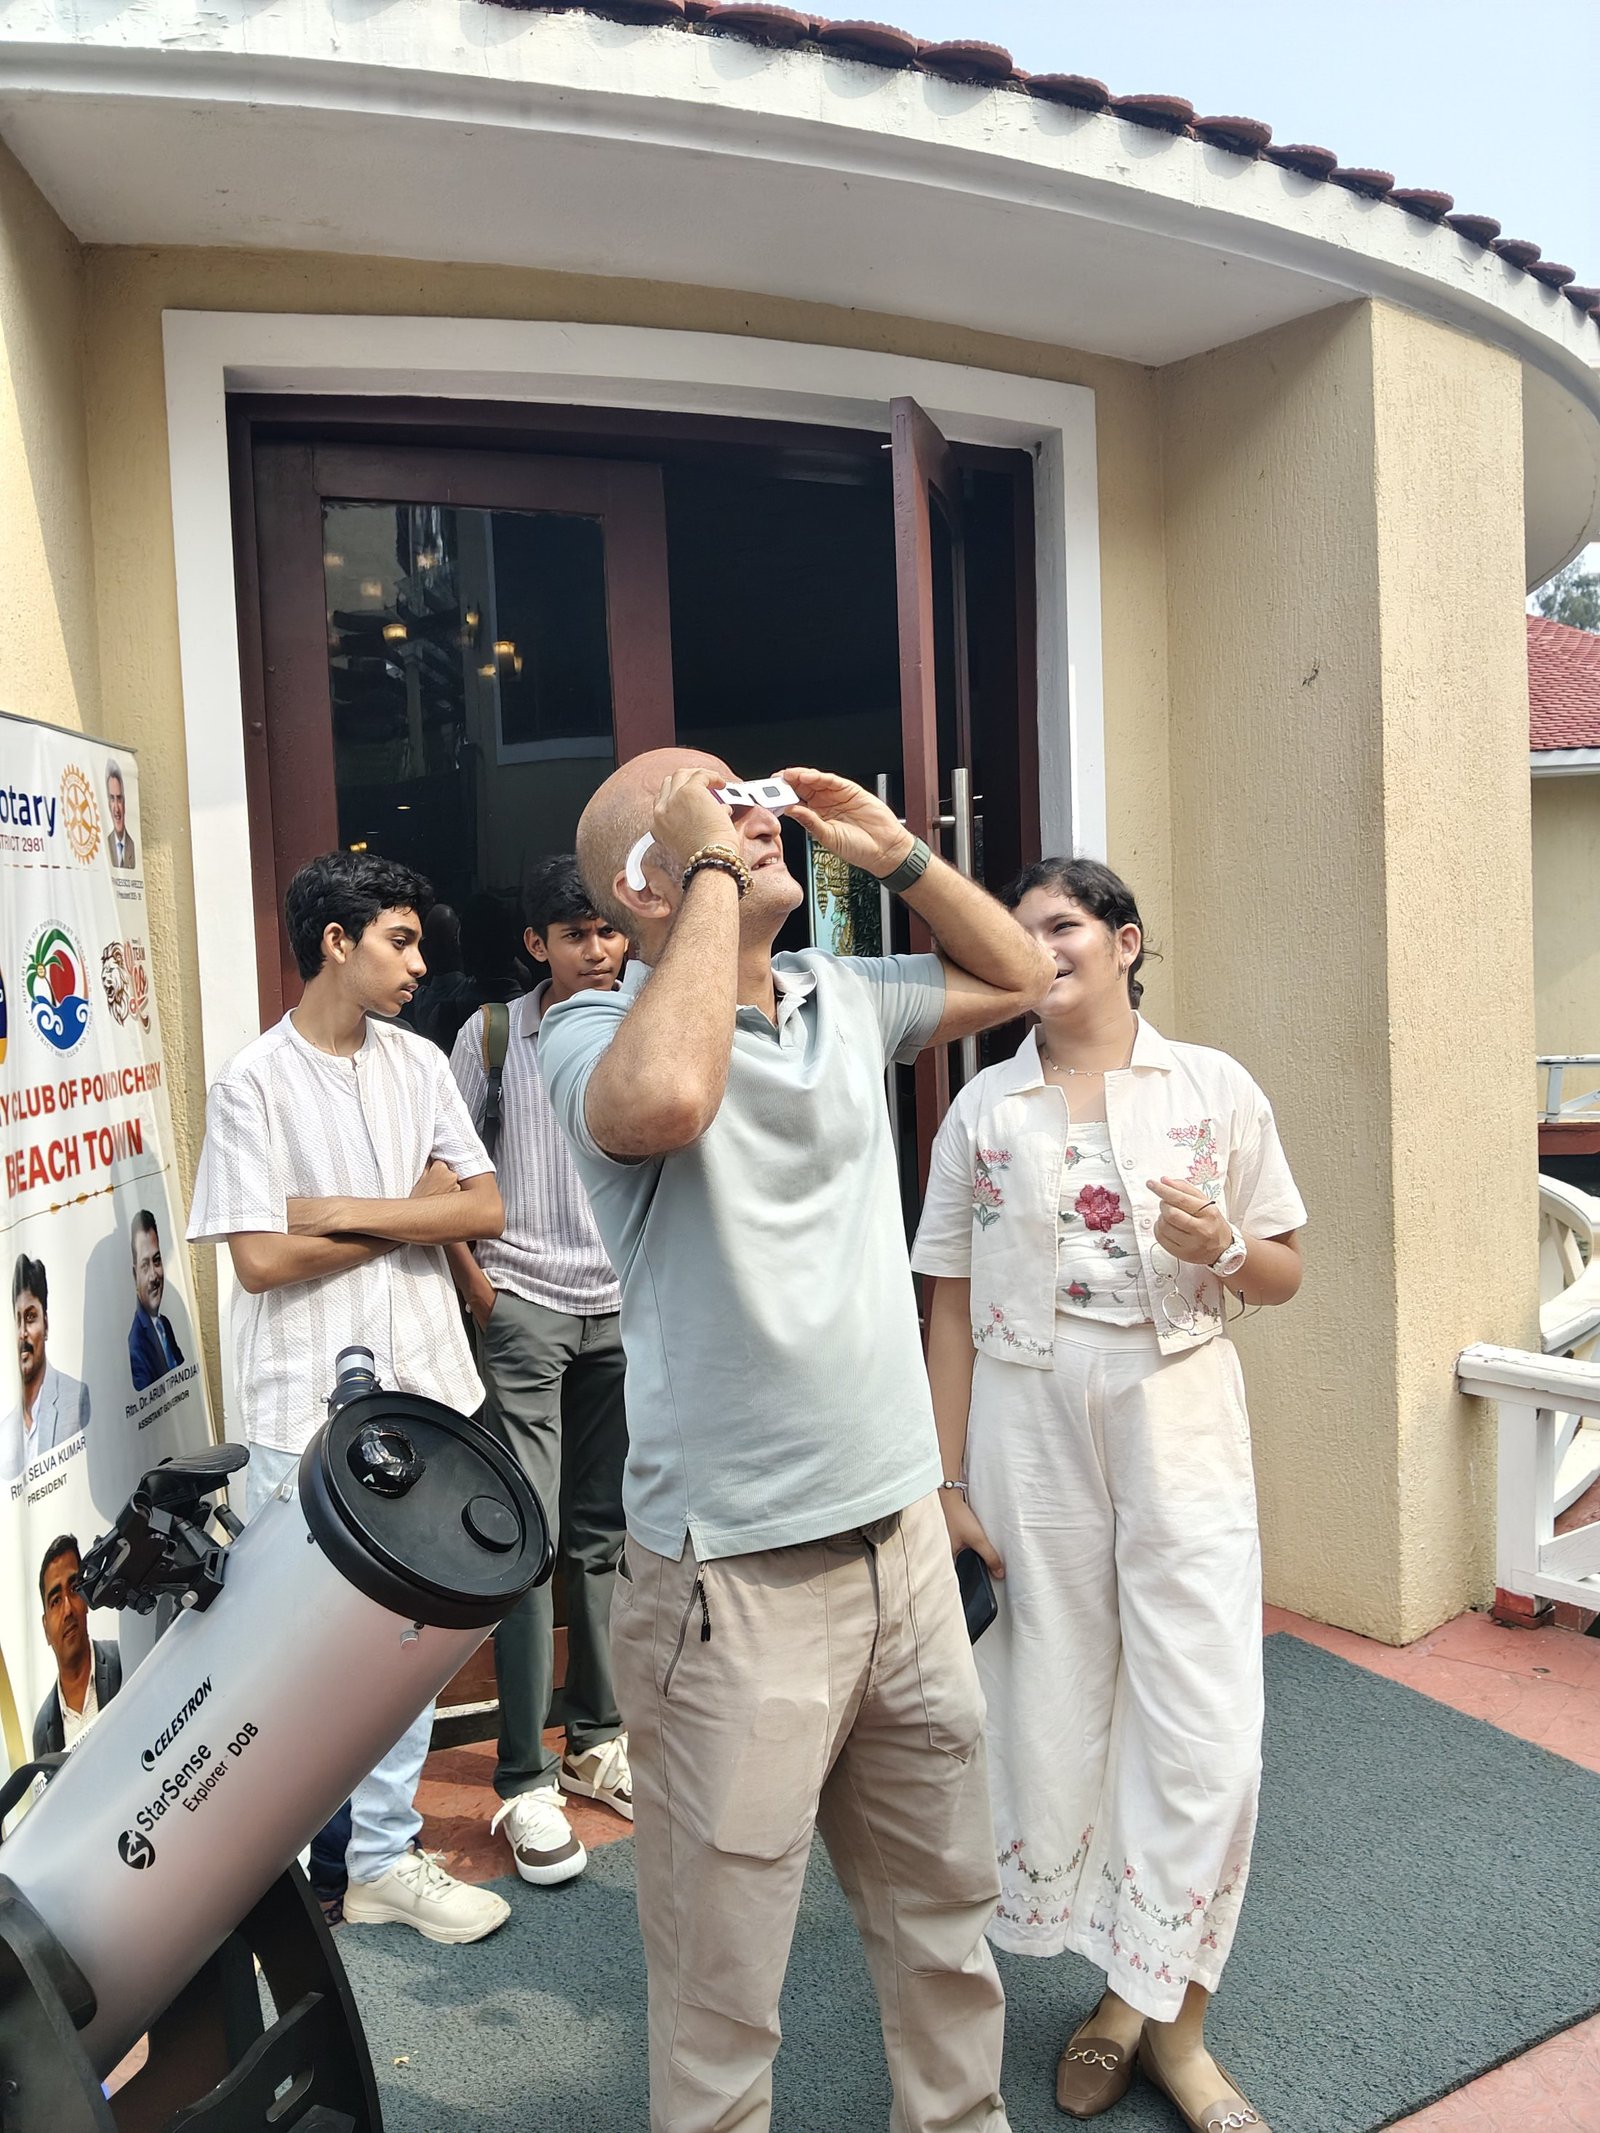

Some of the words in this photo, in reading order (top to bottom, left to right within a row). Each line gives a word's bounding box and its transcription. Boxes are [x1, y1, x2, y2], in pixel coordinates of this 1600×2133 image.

[22, 837, 45, 852] 2981
[0, 1093, 10, 1127] Y
[12, 1084, 56, 1122] CLUB
[59, 1079, 78, 1110] OF
[5, 1134, 81, 1199] BEACH
[83, 1117, 144, 1171] TOWN
[27, 1472, 68, 1508] PRESIDENT
[28, 1454, 58, 1482] SELVA
[57, 1435, 87, 1465] KUMAR
[154, 1675, 212, 1757] CELESTRON
[136, 1744, 212, 1832] StarSense
[182, 1760, 229, 1812] Explorer
[227, 1722, 259, 1757] DOB
